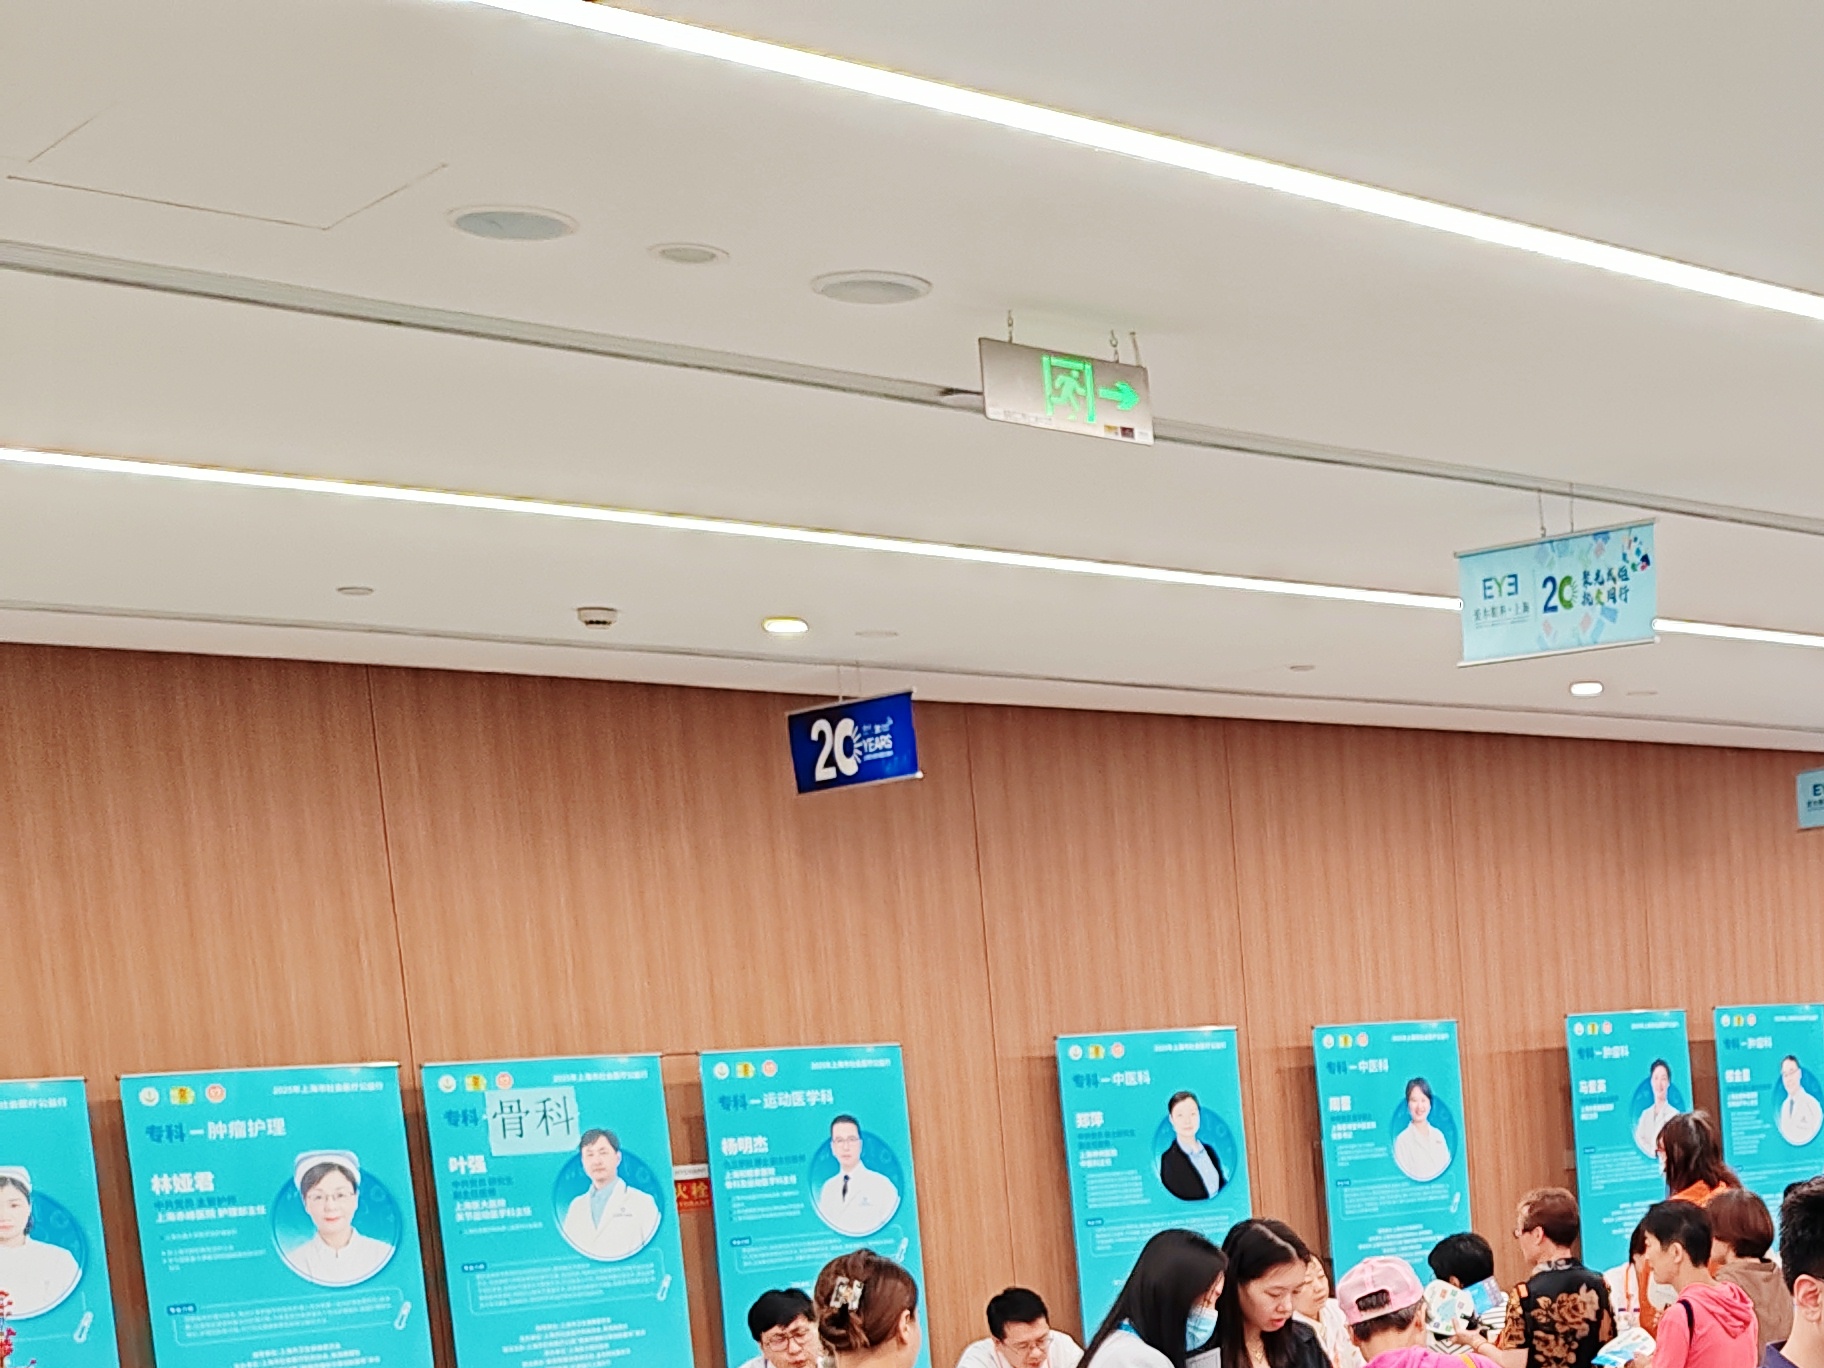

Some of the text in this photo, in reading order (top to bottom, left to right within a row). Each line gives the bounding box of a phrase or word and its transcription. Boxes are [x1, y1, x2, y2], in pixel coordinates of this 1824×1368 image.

[1542, 575, 1576, 614] 20
[810, 718, 893, 782] 20 YEARS
[492, 1095, 575, 1140] 骨科
